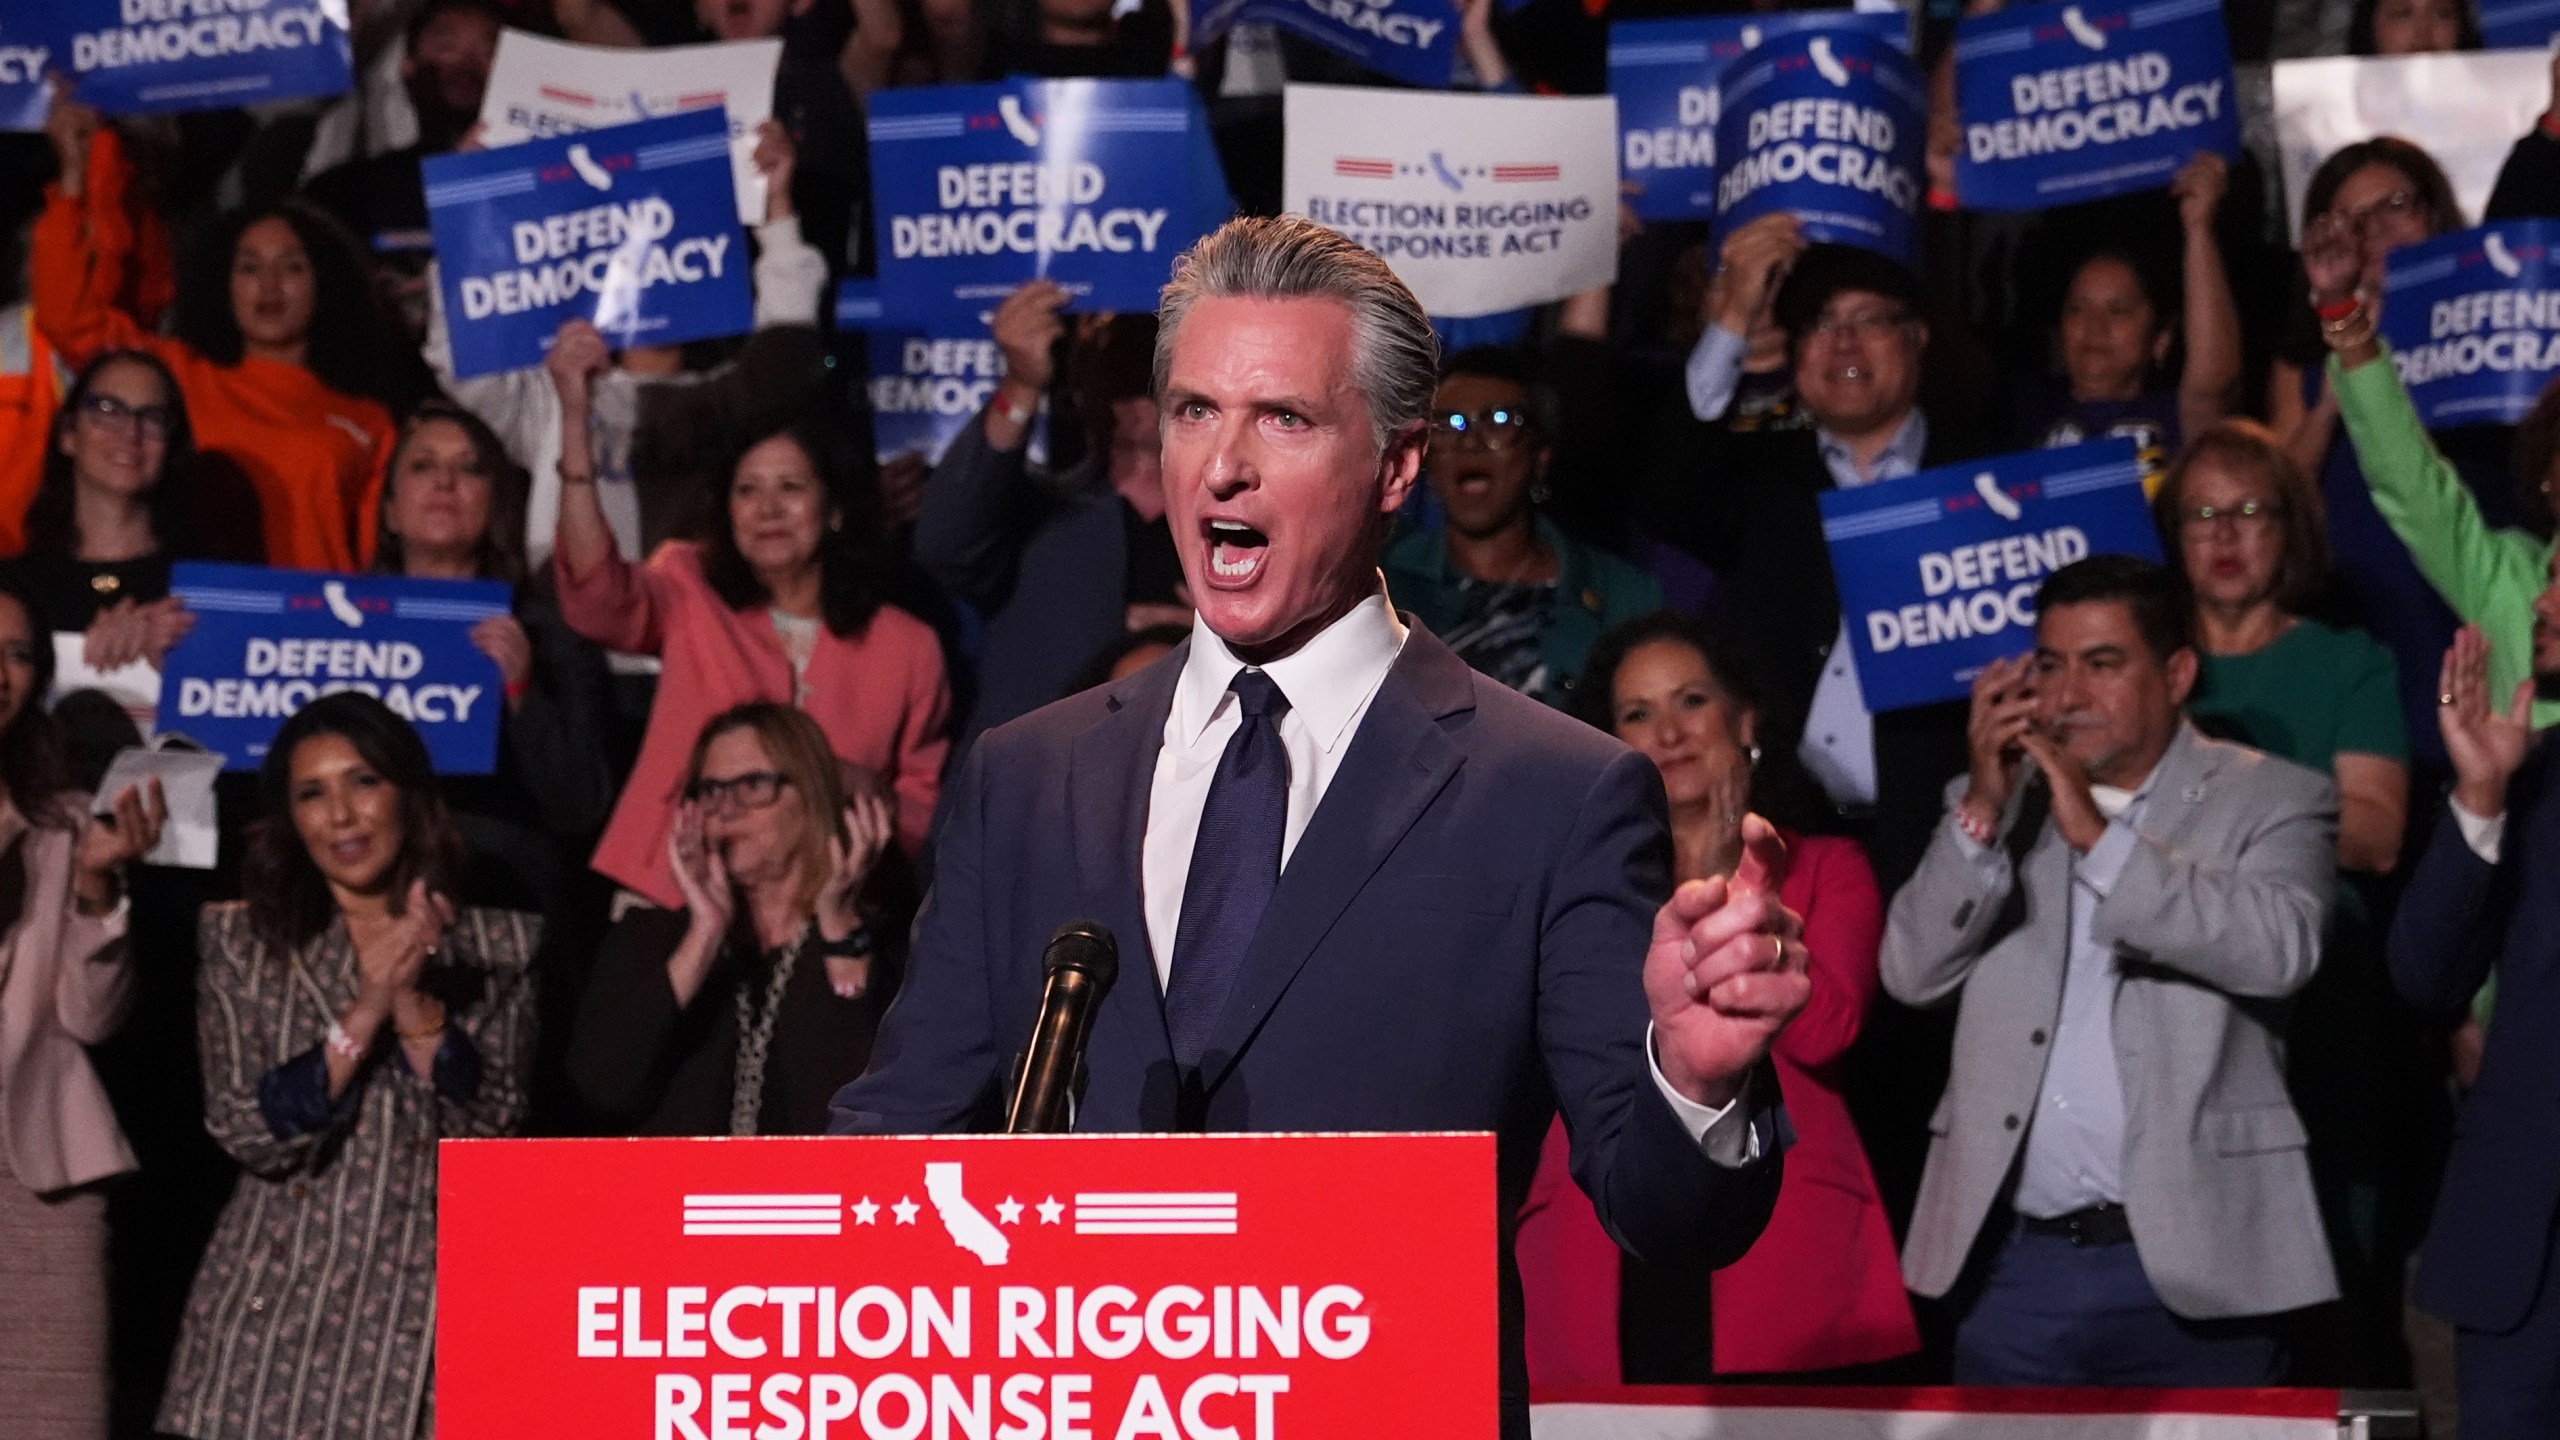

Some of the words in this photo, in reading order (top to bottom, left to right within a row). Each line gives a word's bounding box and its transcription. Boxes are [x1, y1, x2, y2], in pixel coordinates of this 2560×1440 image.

[72, 6, 326, 73] DEMOCRACY
[2011, 50, 2172, 115] DEFEND
[1748, 96, 1896, 152] DEFEND
[1967, 77, 2225, 165] DEMOCRACY
[937, 160, 1107, 210] DEFEND
[1717, 140, 1920, 216] DEMOCRAC
[512, 195, 676, 266] DEFEND
[890, 207, 1169, 260] DEMOCRACY
[1308, 197, 1445, 230] ELECTION
[1455, 195, 1594, 229] RIGGING
[1500, 228, 1562, 255] ACT
[1917, 524, 2091, 598] DEFEND
[1865, 579, 2042, 653] DEMOC
[244, 636, 424, 680] DEFEND
[577, 1285, 971, 1360] ELECTION
[998, 1285, 1370, 1360] RIGGING
[655, 1373, 1092, 1440] RESPONSE
[1114, 1373, 1290, 1440] ACT
